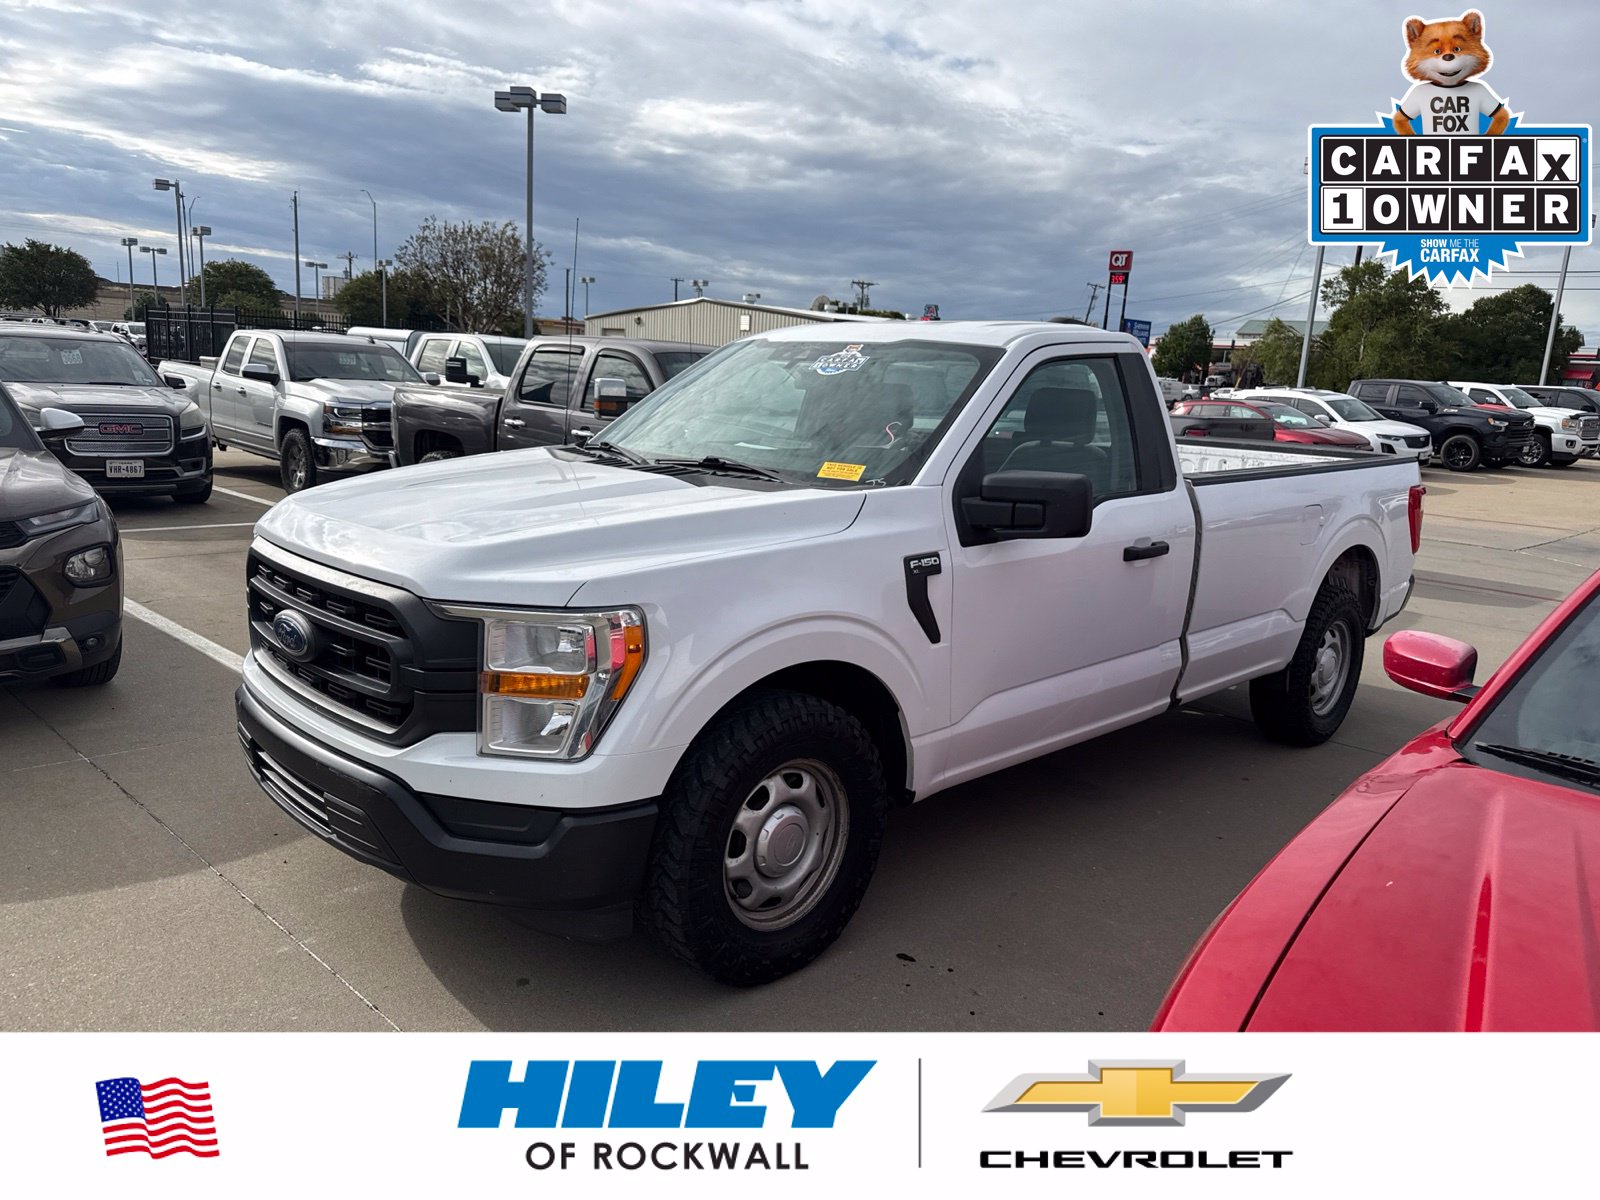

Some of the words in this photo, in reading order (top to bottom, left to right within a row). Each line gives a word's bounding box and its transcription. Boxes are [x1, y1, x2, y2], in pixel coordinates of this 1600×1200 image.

[1111, 253, 1128, 267] QT
[100, 424, 139, 434] GMC
[910, 557, 940, 568] F-150
